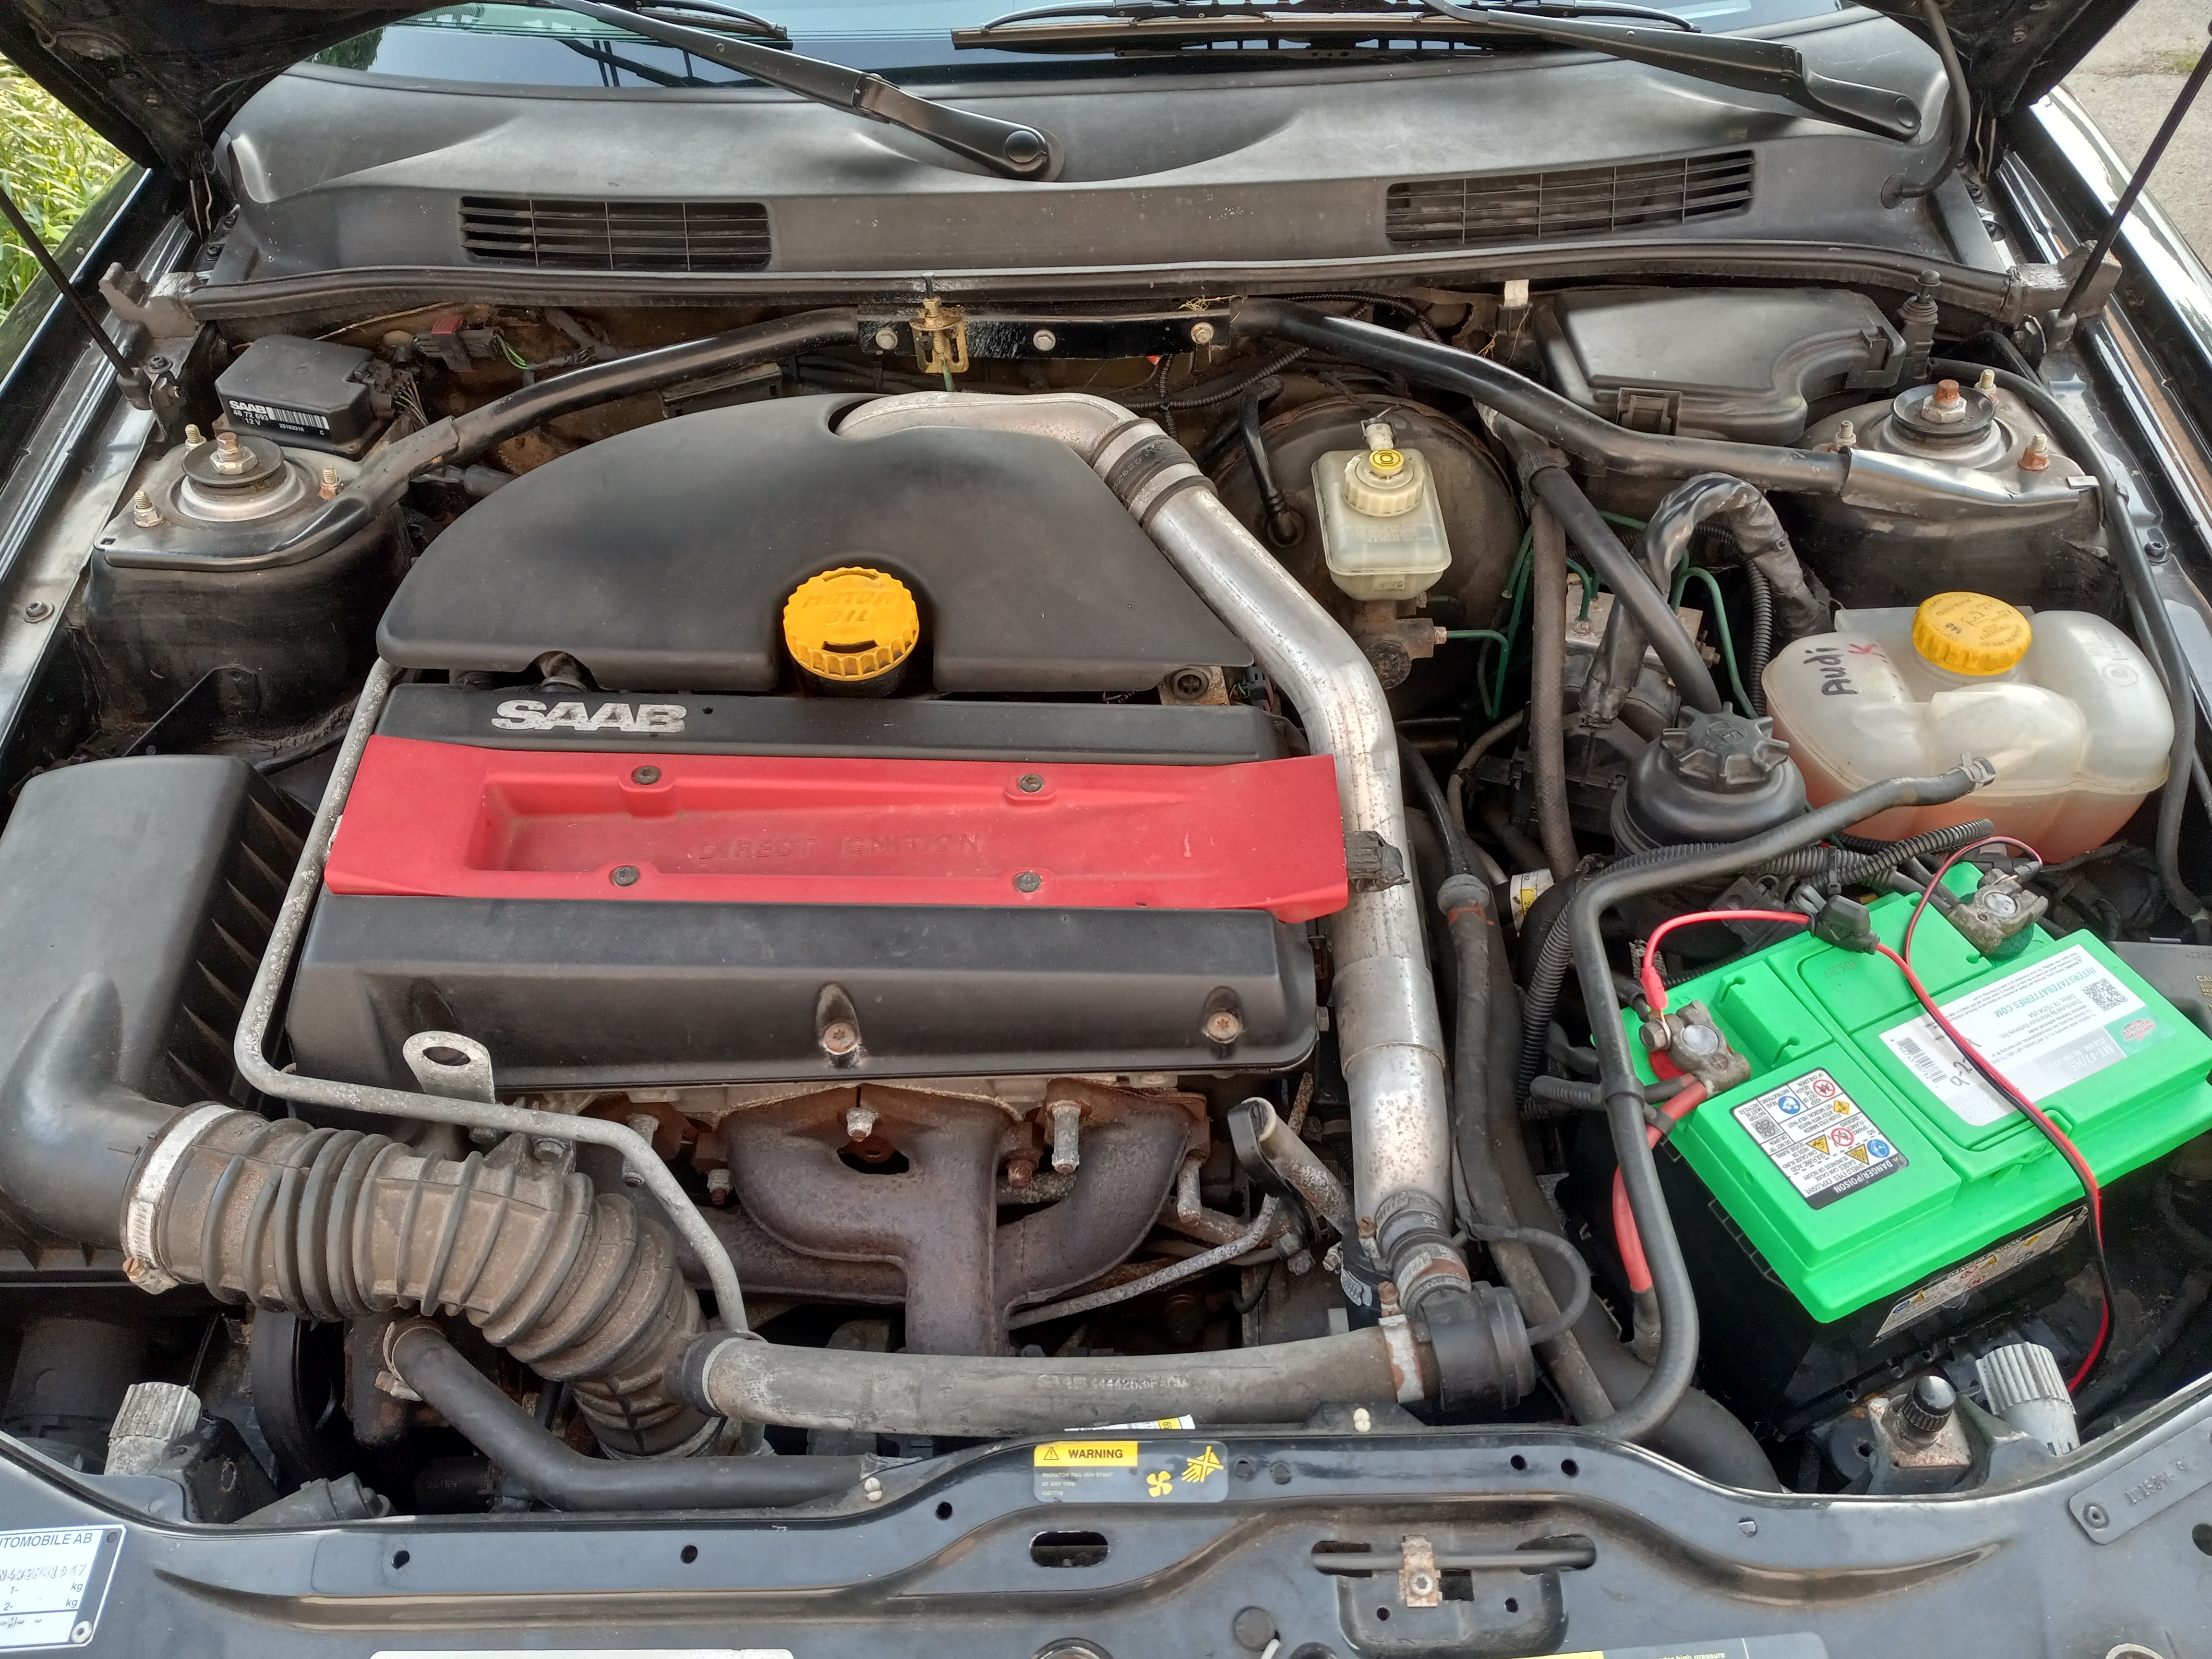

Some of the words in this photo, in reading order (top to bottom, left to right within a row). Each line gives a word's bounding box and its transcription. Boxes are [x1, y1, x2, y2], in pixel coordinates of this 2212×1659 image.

[229, 400, 267, 414] SAAB
[802, 591, 895, 609] MOTOR
[825, 609, 869, 625] OIL
[1803, 647, 1859, 696] Audi
[491, 699, 687, 733] SAAB
[698, 838, 814, 859] DIRECT
[834, 833, 979, 855] IGNITION
[1991, 966, 2098, 1018] INTERSTATEBATTERIES.COM
[2037, 1004, 2055, 1013] 75254
[2055, 998, 2082, 1013] Distributed
[2027, 1010, 2040, 1018] USA
[2027, 1012, 2052, 1026] Interstate
[2007, 1022, 2031, 1035] Batteries
[2081, 1043, 2096, 1051] 650
[2092, 1037, 2107, 1046] CCA
[2065, 1043, 2116, 1071] MT-47/H5
[1794, 1084, 1810, 1094] REACH
[1747, 1110, 1767, 1121] BATTERY
[1806, 1107, 1825, 1118] MEDICAL
[1820, 1110, 1834, 1118] ATELY
[1827, 1113, 1842, 1122] FLUSH
[1786, 1119, 1799, 1128] FAST.
[1796, 1115, 1809, 1123] HELP
[1817, 1118, 1829, 1127] EYES
[1839, 1115, 1860, 1127] SMOKING
[1846, 1119, 1864, 1130] FLAMES
[1851, 1124, 1869, 1135] SPARKS
[1767, 1137, 1781, 1146] OPEN.
[1789, 1142, 1805, 1152] SEVERE
[1774, 1149, 1791, 1159] BURNS.
[1797, 1146, 1809, 1154] NESS
[1794, 1154, 1809, 1163] CAUSE
[1802, 1152, 1826, 1167] SULFURIC
[1824, 1155, 1848, 1170] BLINDNESS
[1838, 1158, 1856, 1170] GASES
[1781, 1160, 1796, 1169] BLIND-
[1790, 1163, 1804, 1173] ACID
[1827, 1166, 1839, 1174] CAN
[1845, 1162, 1865, 1174] SHIELD
[1801, 1169, 1819, 1180] INJURY.
[1814, 1171, 1830, 1181] CAUSE
[1831, 1171, 1847, 1181] EYES.
[1832, 1159, 1893, 1195] DANGER/POISON
[1803, 1178, 1833, 1195] EXPLOSIVE
[1068, 1449, 1123, 1458] WARNING
[73, 1533, 93, 1544] AB
[71, 1582, 83, 1592] kg
[65, 1598, 78, 1609] kg
